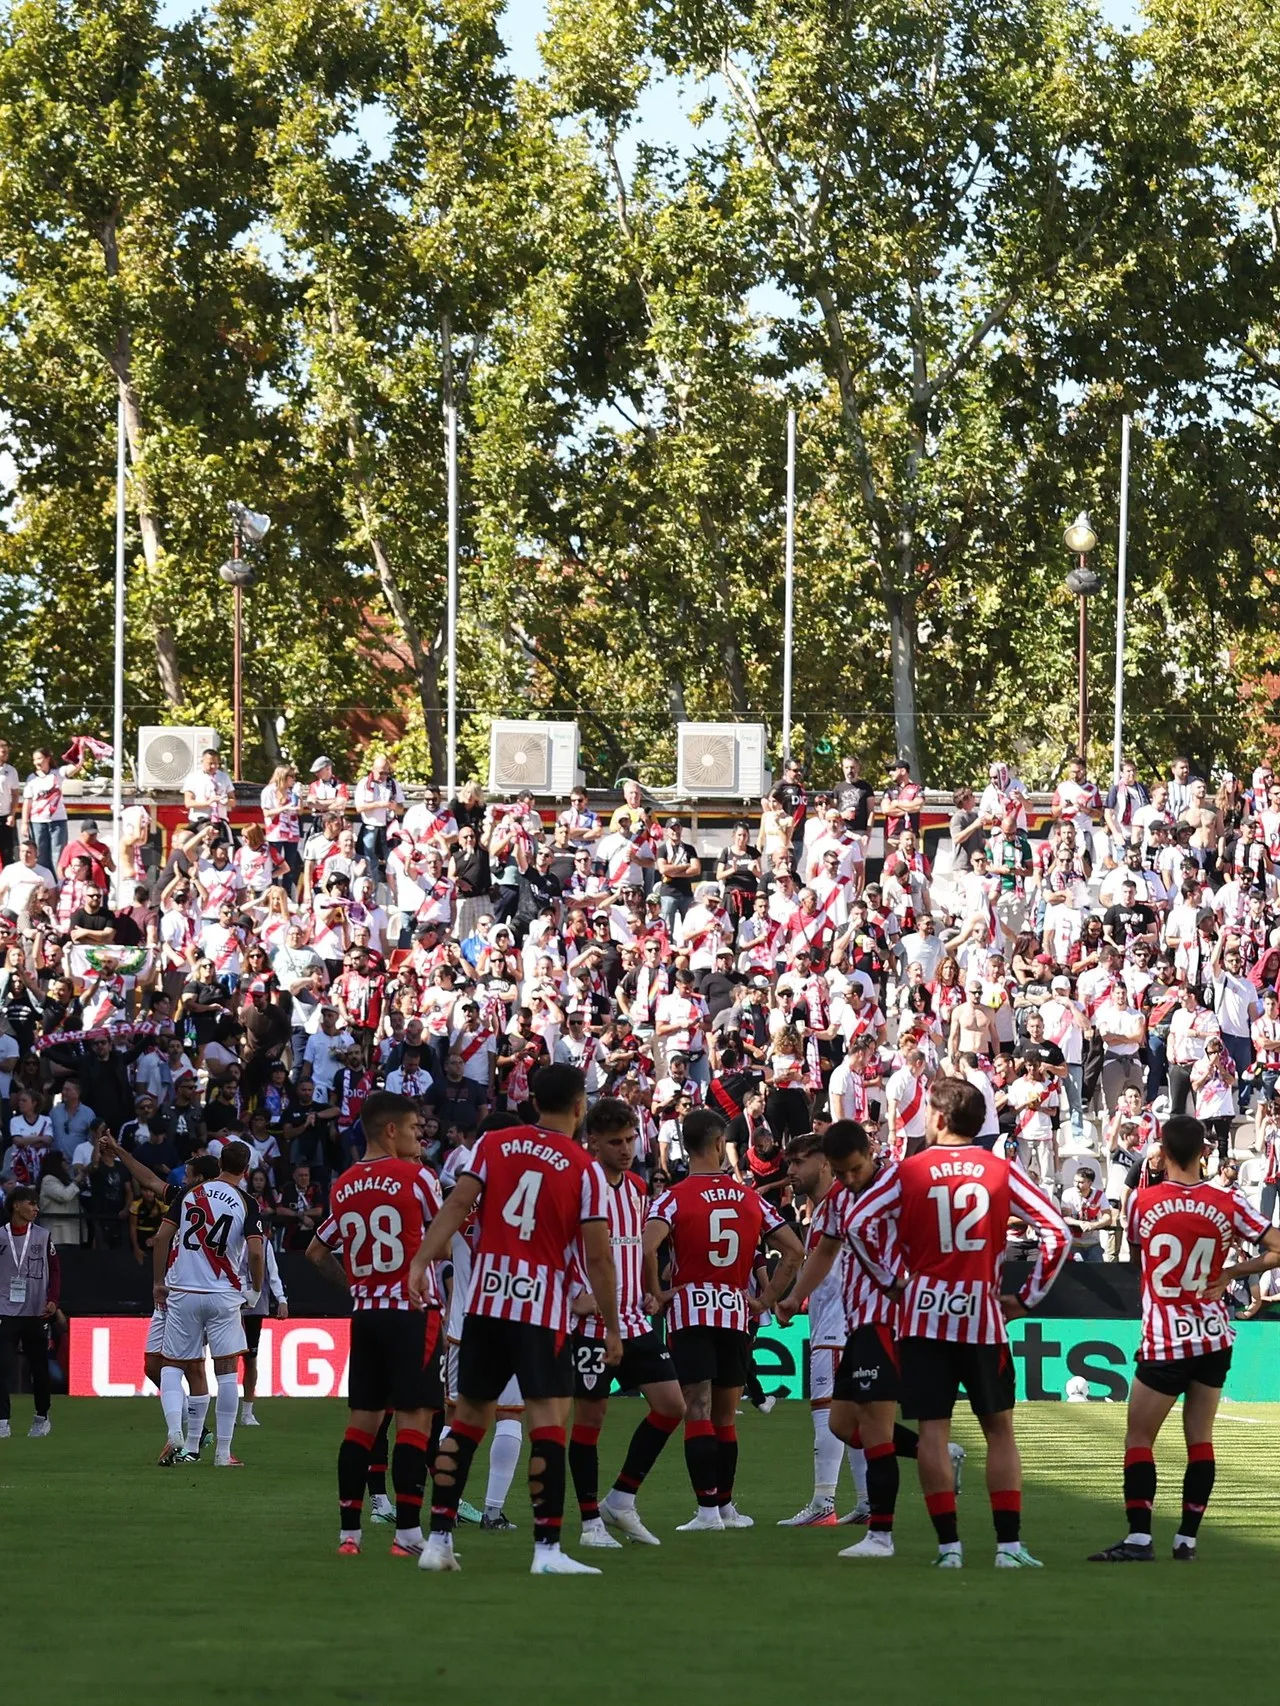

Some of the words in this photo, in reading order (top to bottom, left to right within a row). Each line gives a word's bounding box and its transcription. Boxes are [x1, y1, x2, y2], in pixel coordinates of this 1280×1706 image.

[501, 1138, 570, 1172] PAREDES
[929, 1161, 986, 1181] ARESO
[335, 1176, 402, 1203] CANALES
[502, 1169, 543, 1242] 4
[700, 1188, 745, 1204] YERAY
[183, 1206, 234, 1257] 24
[927, 1182, 990, 1254] 12
[340, 1204, 404, 1278] 28
[708, 1208, 739, 1268] 5
[1149, 1233, 1216, 1299] 24
[483, 1271, 541, 1301] DIGI
[692, 1290, 741, 1311] DIGI
[917, 1289, 976, 1317] DIGI
[577, 1346, 606, 1374] 23
